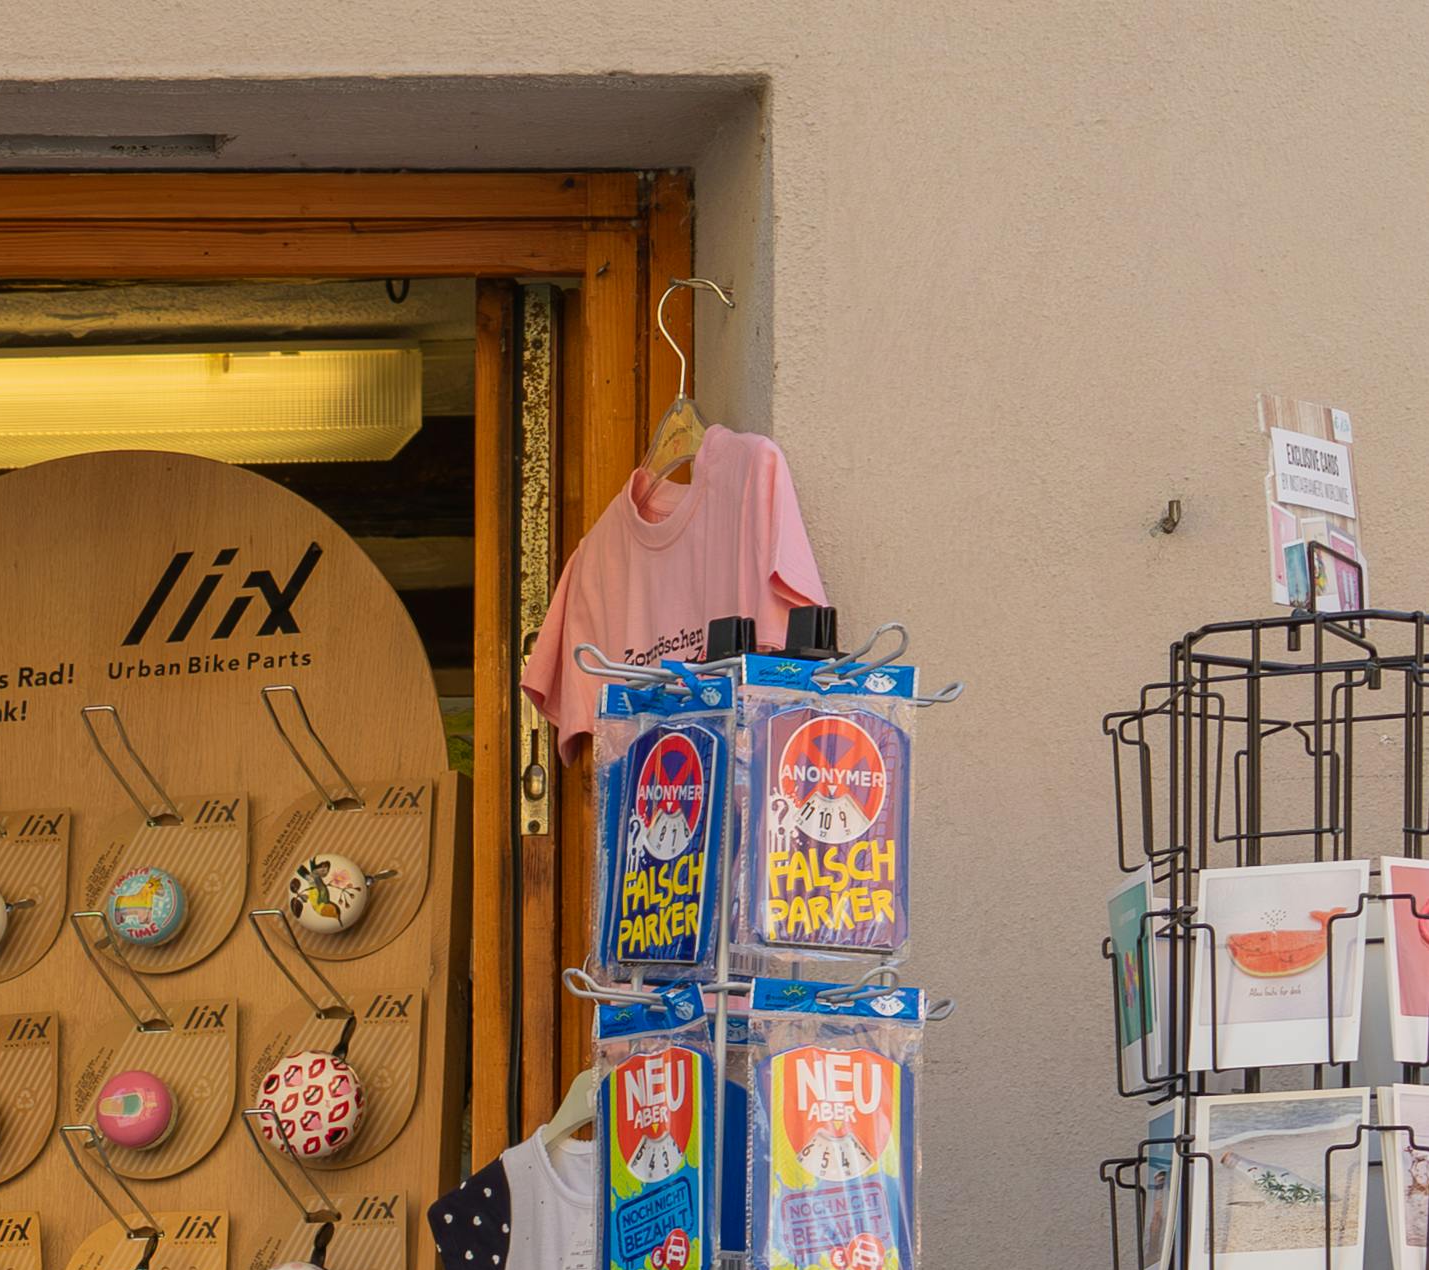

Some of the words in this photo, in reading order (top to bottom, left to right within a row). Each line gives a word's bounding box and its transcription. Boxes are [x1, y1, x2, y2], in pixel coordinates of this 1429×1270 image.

[1286, 442, 1318, 472] EXCLUSIVE
[1319, 450, 1339, 477] CARDS
[15, 662, 76, 690] Rad!
[107, 656, 181, 681] Urban
[187, 651, 242, 677] Bike
[247, 648, 313, 673] Parts
[639, 784, 704, 802] ANONYMER
[780, 765, 886, 789] ANONYMER
[818, 811, 832, 831] 10
[838, 810, 847, 827] 9
[622, 852, 705, 919] FALSCH
[769, 840, 896, 898] FALSCH
[767, 887, 896, 940] PARKER
[126, 923, 160, 939] TIME
[618, 903, 700, 959] PARKER
[625, 1057, 686, 1121] NEU
[796, 1054, 882, 1110] NEU
[633, 1105, 669, 1129] ABER
[807, 1105, 856, 1123] ABER
[621, 1200, 654, 1227] NOCH
[654, 1187, 687, 1214] NICHT
[789, 1200, 832, 1220] NOCH
[835, 1190, 881, 1211] NICHT
[625, 1210, 690, 1253] BEZAHLT
[792, 1214, 882, 1248] BEZAHLT
